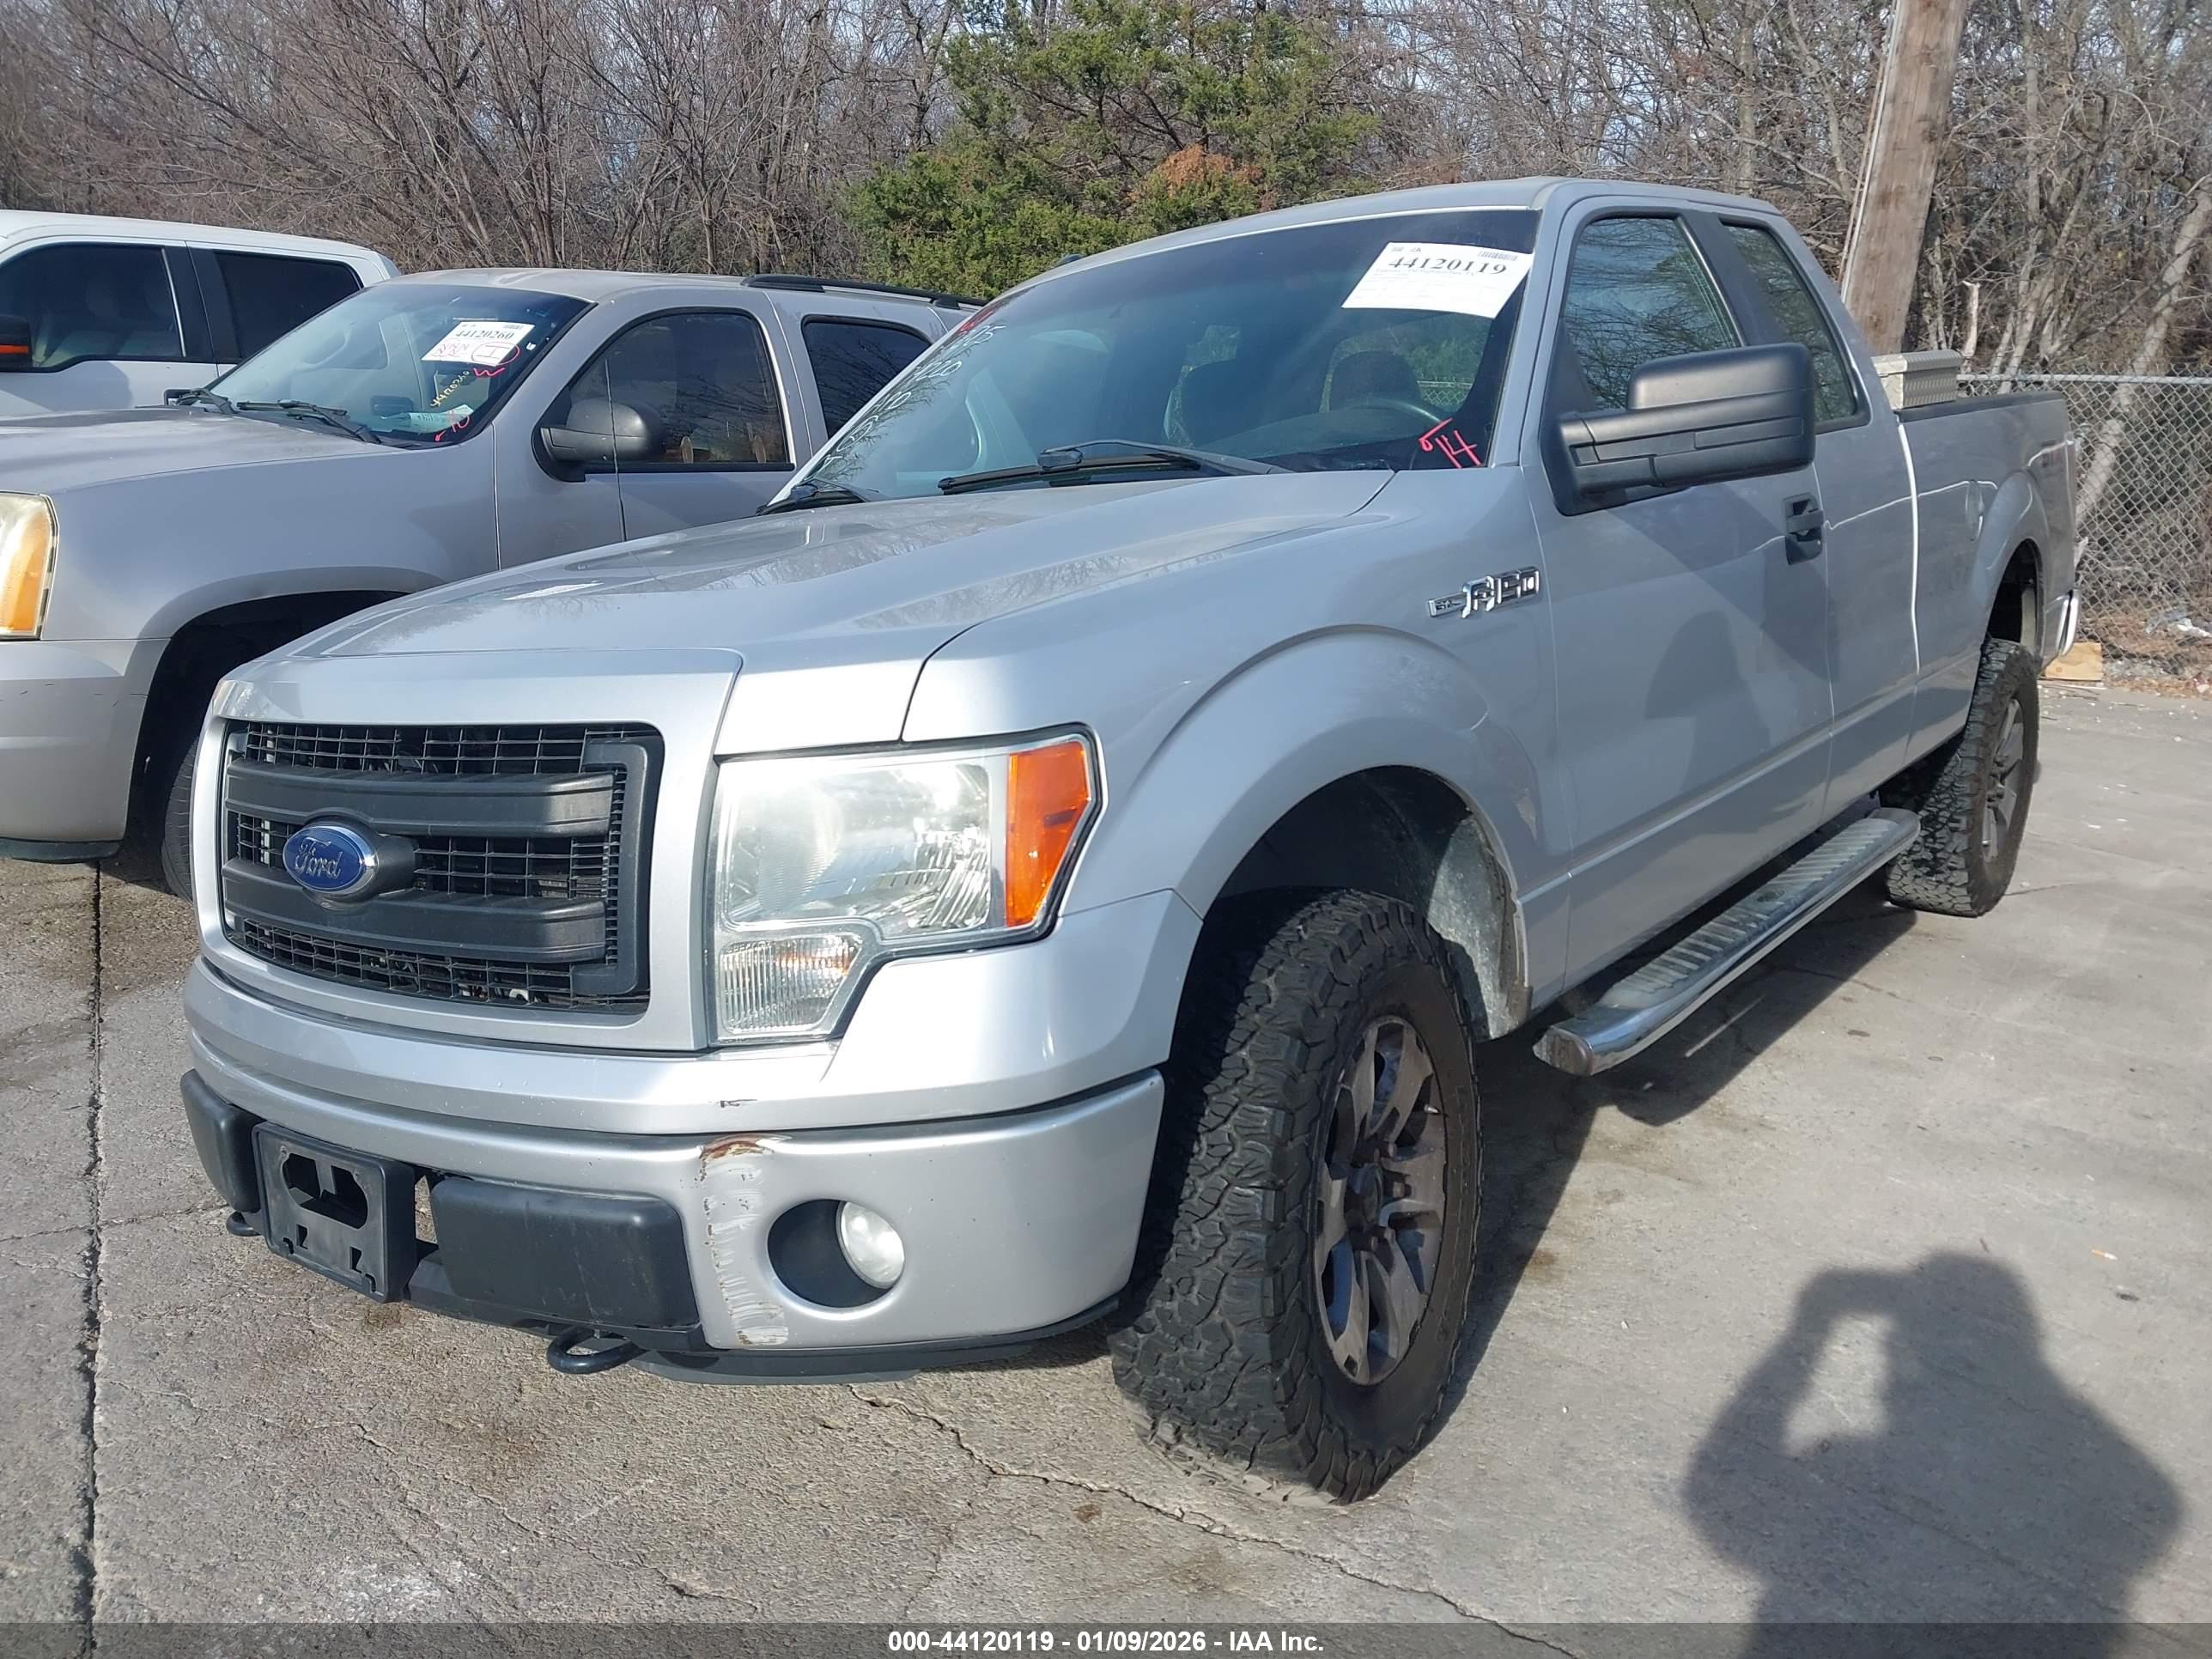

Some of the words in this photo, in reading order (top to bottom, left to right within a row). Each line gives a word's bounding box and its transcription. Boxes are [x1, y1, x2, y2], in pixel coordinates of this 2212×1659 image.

[1388, 256, 1508, 275] 44120119
[455, 329, 515, 340] 44120260
[295, 836, 343, 879] Ford
